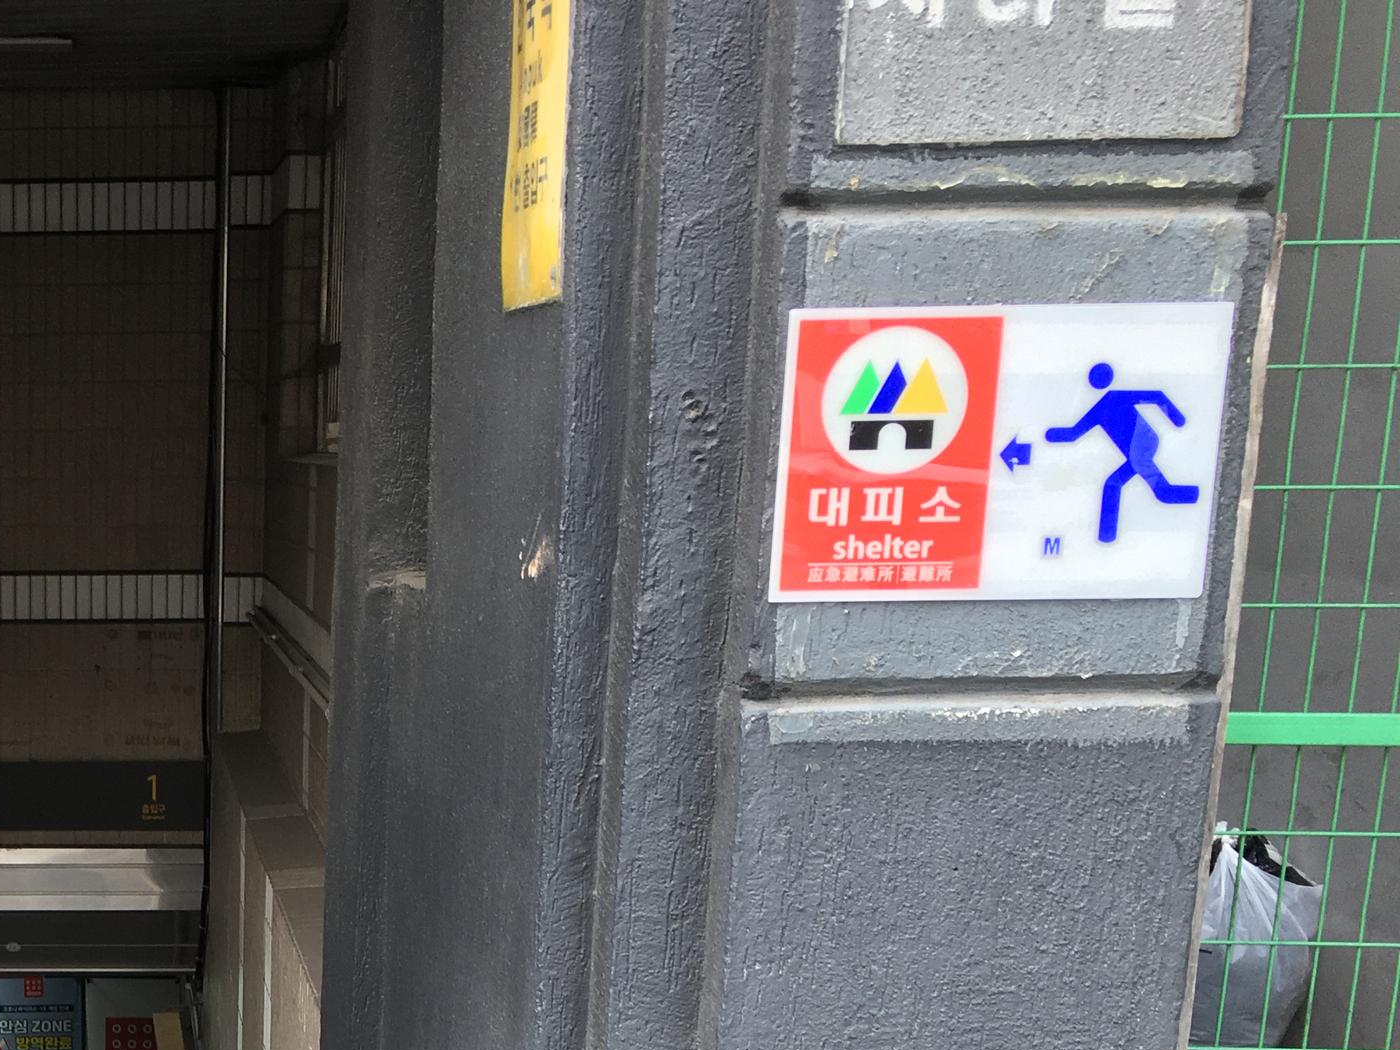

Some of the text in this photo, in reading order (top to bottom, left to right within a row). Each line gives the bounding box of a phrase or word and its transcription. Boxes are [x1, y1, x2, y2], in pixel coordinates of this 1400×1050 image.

[808, 486, 961, 527] 대피소
[832, 534, 934, 560] shelter
[1043, 537, 1061, 555] M
[146, 775, 157, 801] 1
[0, 1019, 72, 1034] 안심 ZONE
[15, 1036, 73, 1050] 방역완료
